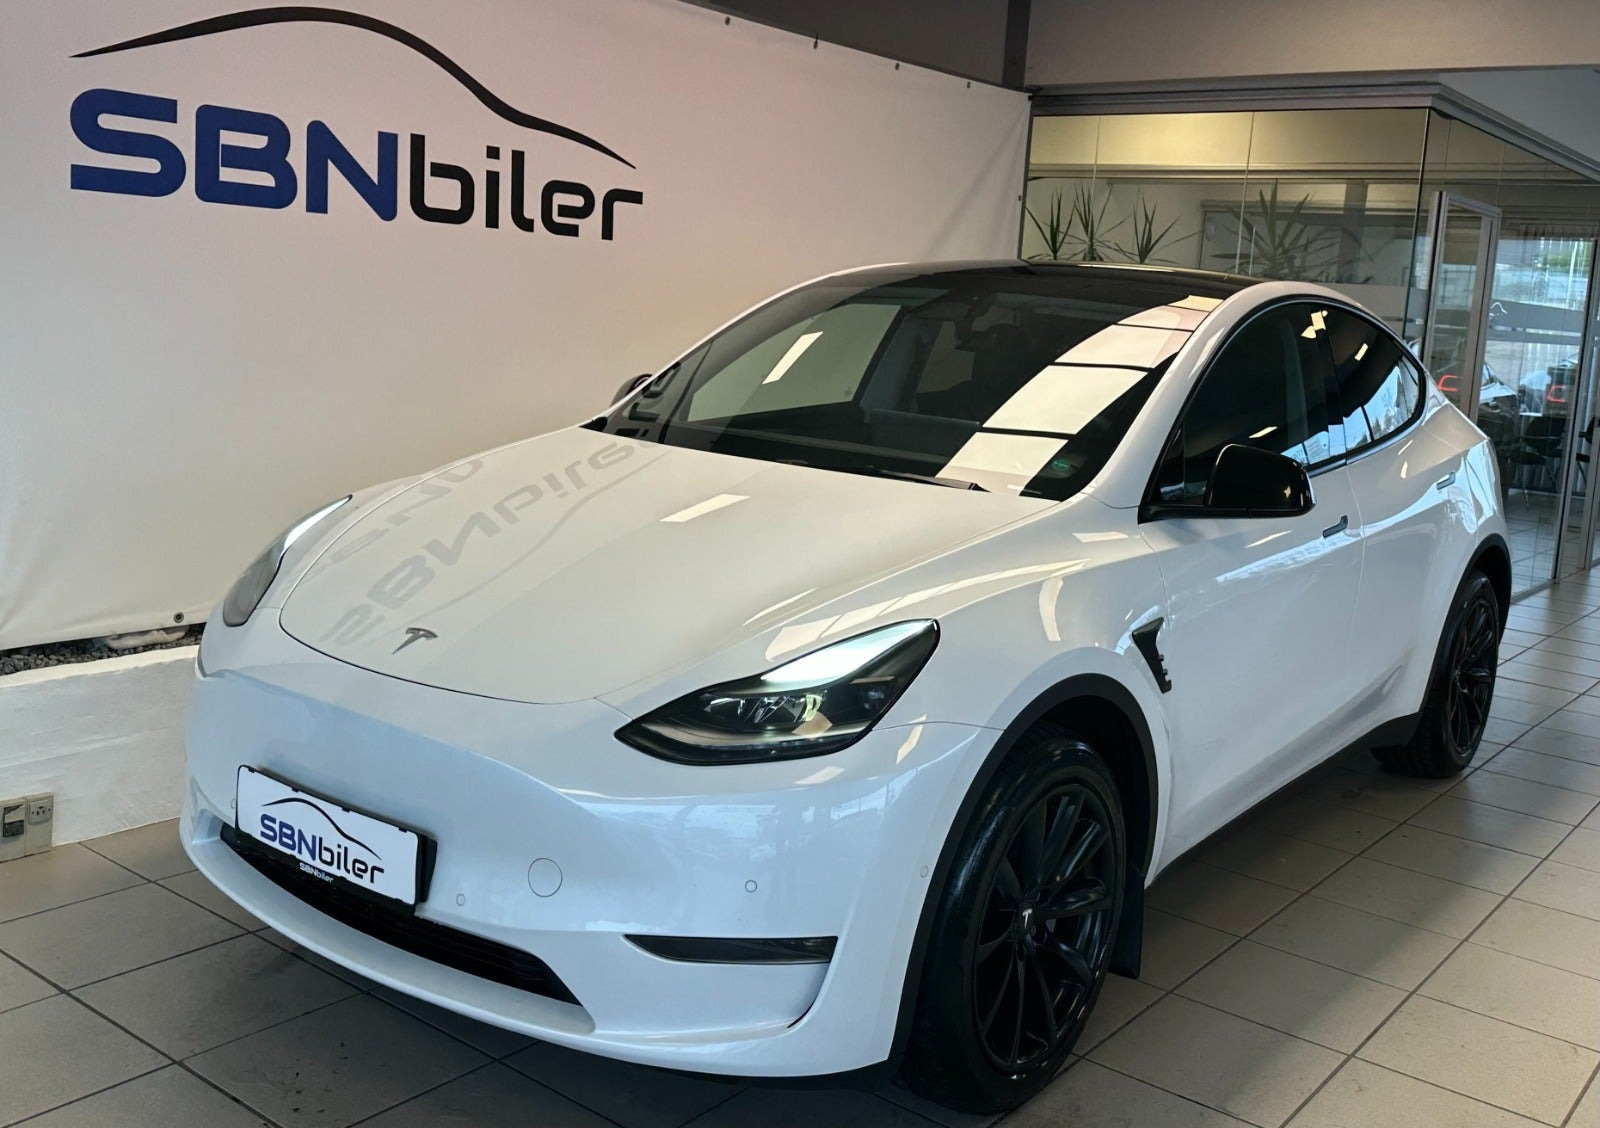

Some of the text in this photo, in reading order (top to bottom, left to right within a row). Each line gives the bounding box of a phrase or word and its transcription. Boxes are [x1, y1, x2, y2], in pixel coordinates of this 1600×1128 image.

[70, 88, 643, 241] SBNbiler
[260, 813, 385, 884] SBNbiler
[299, 862, 334, 883] SBNbiler
